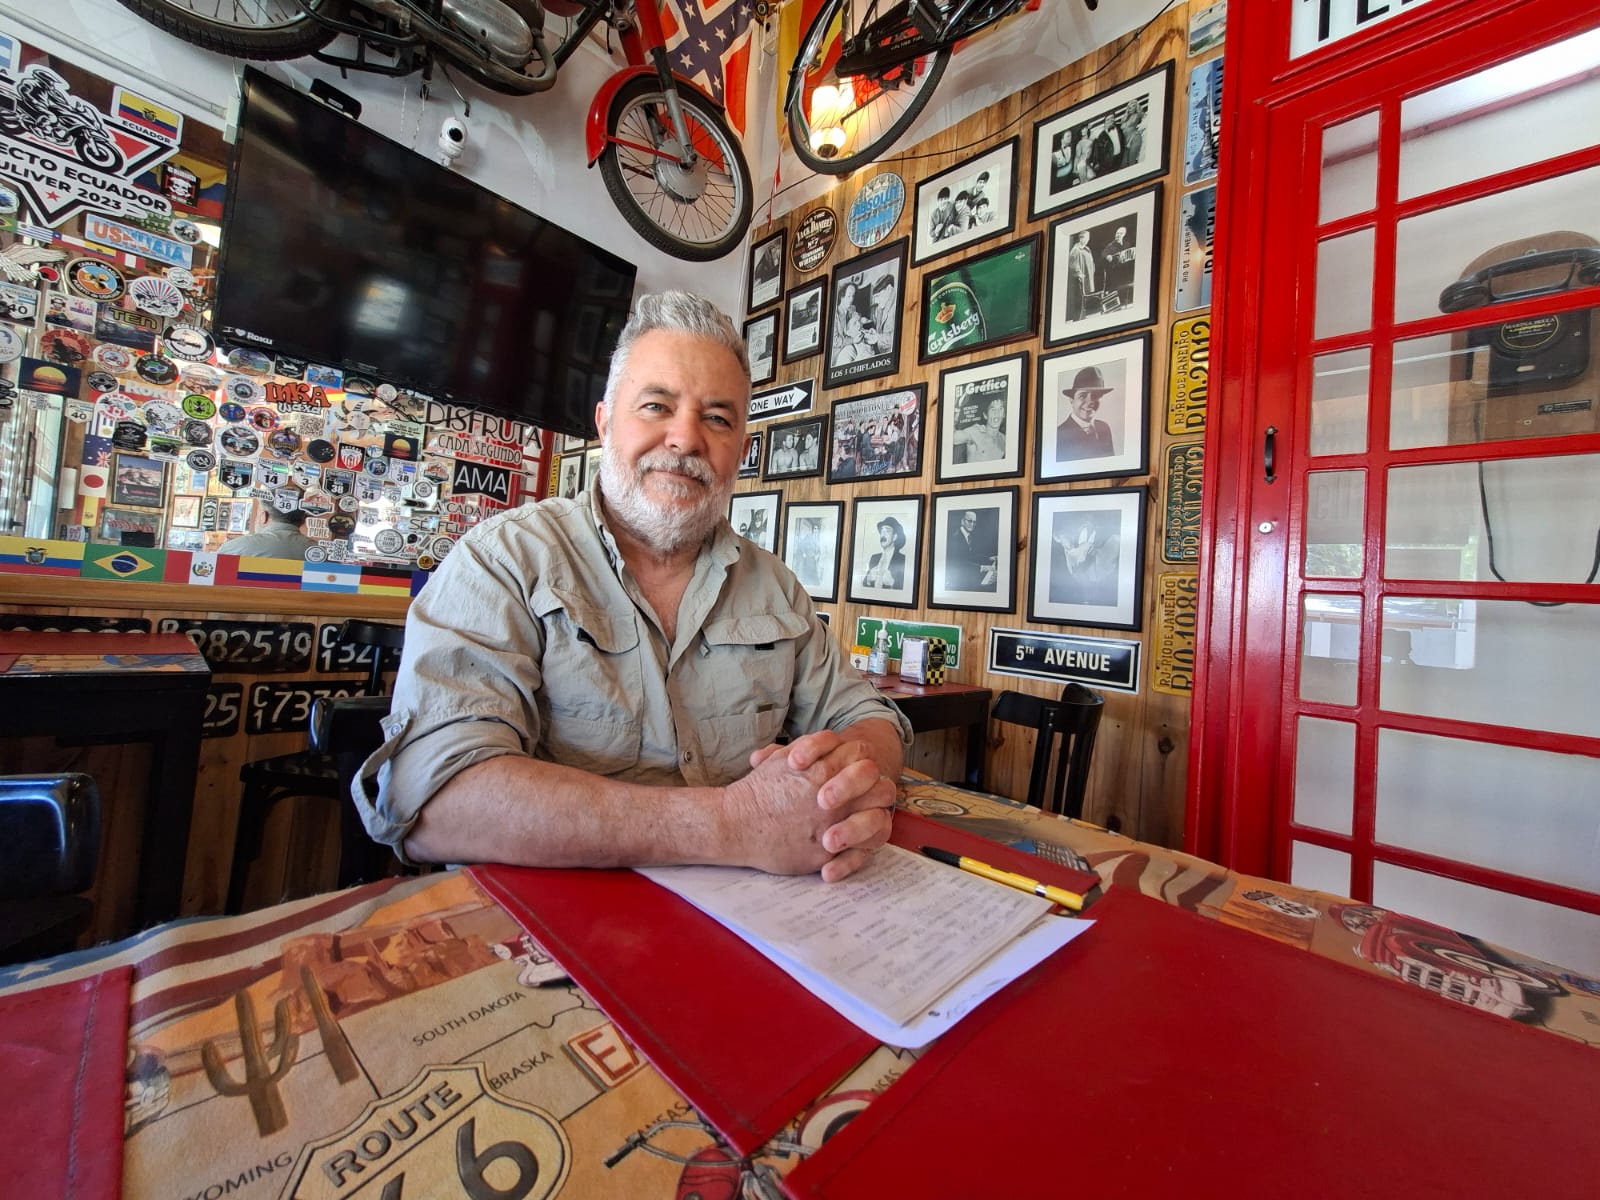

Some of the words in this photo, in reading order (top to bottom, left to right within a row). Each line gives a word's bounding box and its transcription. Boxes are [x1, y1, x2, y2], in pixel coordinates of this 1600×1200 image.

[122, 120, 171, 143] ECUADOR
[63, 166, 168, 213] ECUADOR
[77, 187, 122, 210] 2023
[852, 182, 899, 217] ABSOLUT
[927, 312, 980, 355] Carlsberg
[1178, 330, 1190, 374] JANEIRO
[831, 369, 843, 379] LOS
[849, 357, 892, 375] CHIFLADOS
[965, 378, 1008, 396] Gráfico
[1178, 376, 1186, 389] DE
[750, 399, 769, 413] ONE
[774, 391, 795, 408] WAY
[70, 410, 88, 421] 40
[425, 400, 542, 450] DISFRUTA
[438, 433, 471, 453] CADA
[473, 439, 522, 465] SEGUNDO
[263, 474, 279, 485] 14
[302, 478, 310, 486] 3
[331, 483, 345, 494] 38
[396, 473, 410, 483] 38
[454, 463, 508, 498] AMA
[279, 502, 292, 510] 38
[361, 490, 375, 500] 34
[362, 514, 376, 525] 40
[446, 502, 483, 517] CADA
[1164, 580, 1176, 632] JANEIRO
[861, 622, 867, 636] S
[1164, 633, 1174, 646] DE
[1015, 644, 1035, 662] 5TH
[1043, 647, 1111, 672] AVENUE
[253, 685, 270, 708] C
[253, 709, 264, 730] 1
[411, 1016, 467, 1047] SOUTH
[467, 990, 528, 1023] DAKOTA
[321, 1080, 464, 1189] ROUTE
